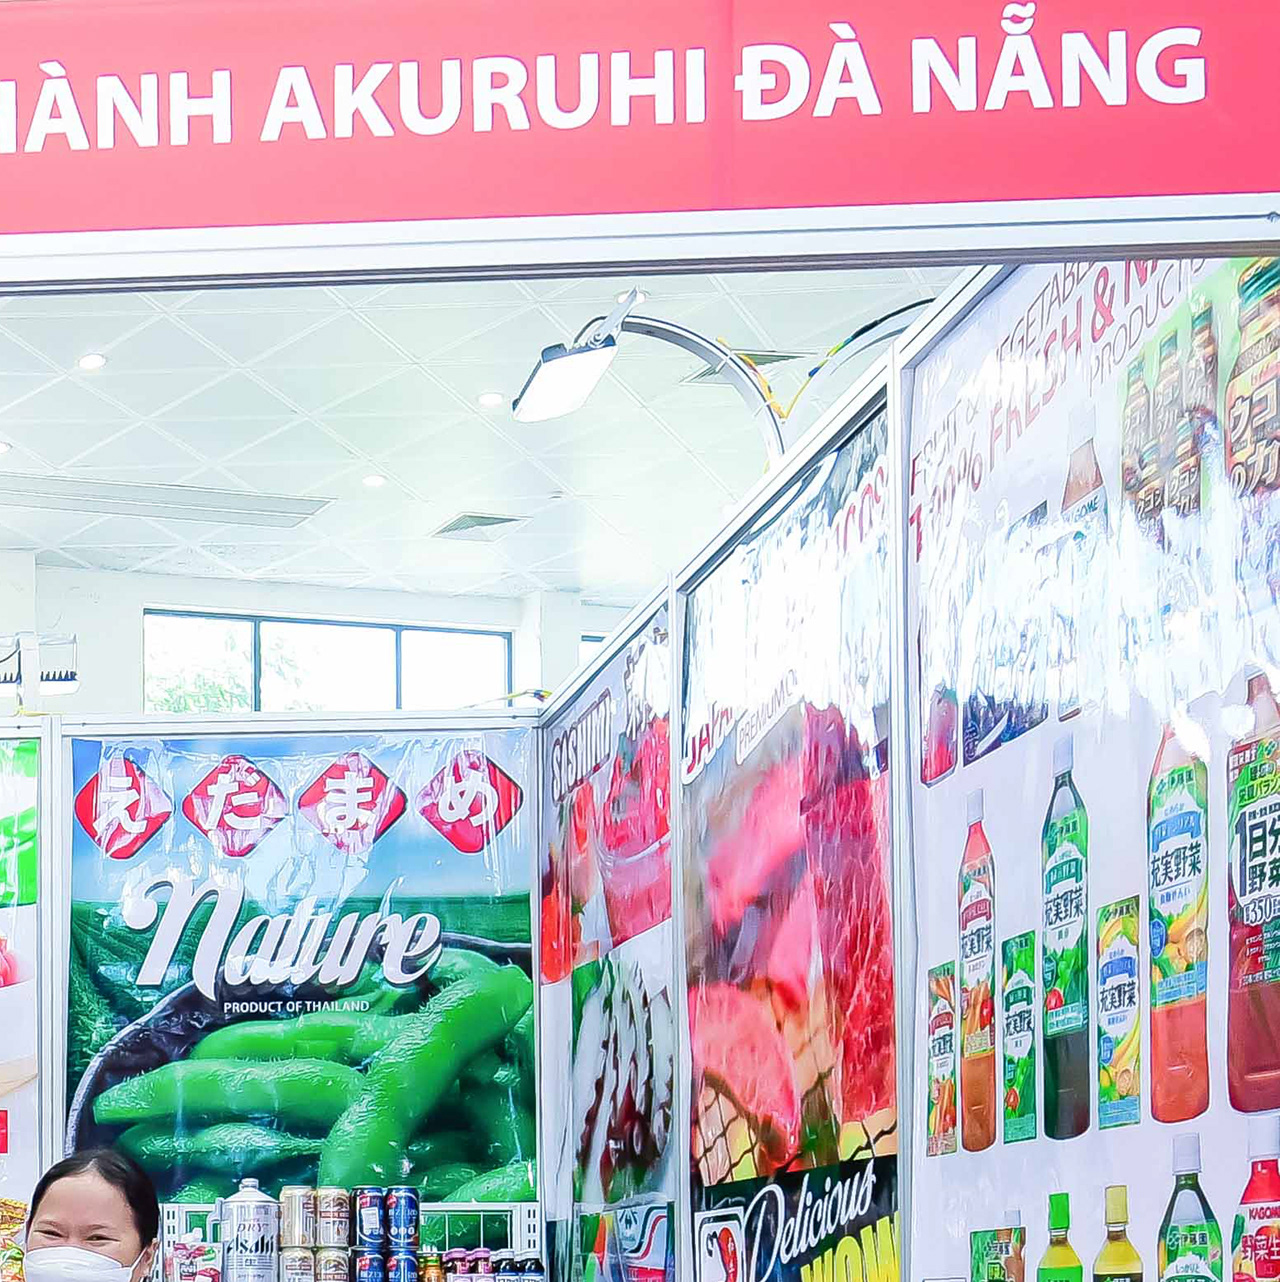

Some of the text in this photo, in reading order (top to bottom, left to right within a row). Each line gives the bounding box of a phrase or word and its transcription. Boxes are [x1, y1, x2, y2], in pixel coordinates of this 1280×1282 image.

[260, 47, 707, 142] AKURUHI
[735, 21, 883, 124] ĐÀ
[910, 2, 1208, 115] NẴNG
[1151, 841, 1202, 888] 充実野菜
[124, 879, 443, 1001] Nature
[224, 999, 370, 1014] PRODUCT OF THAILAND
